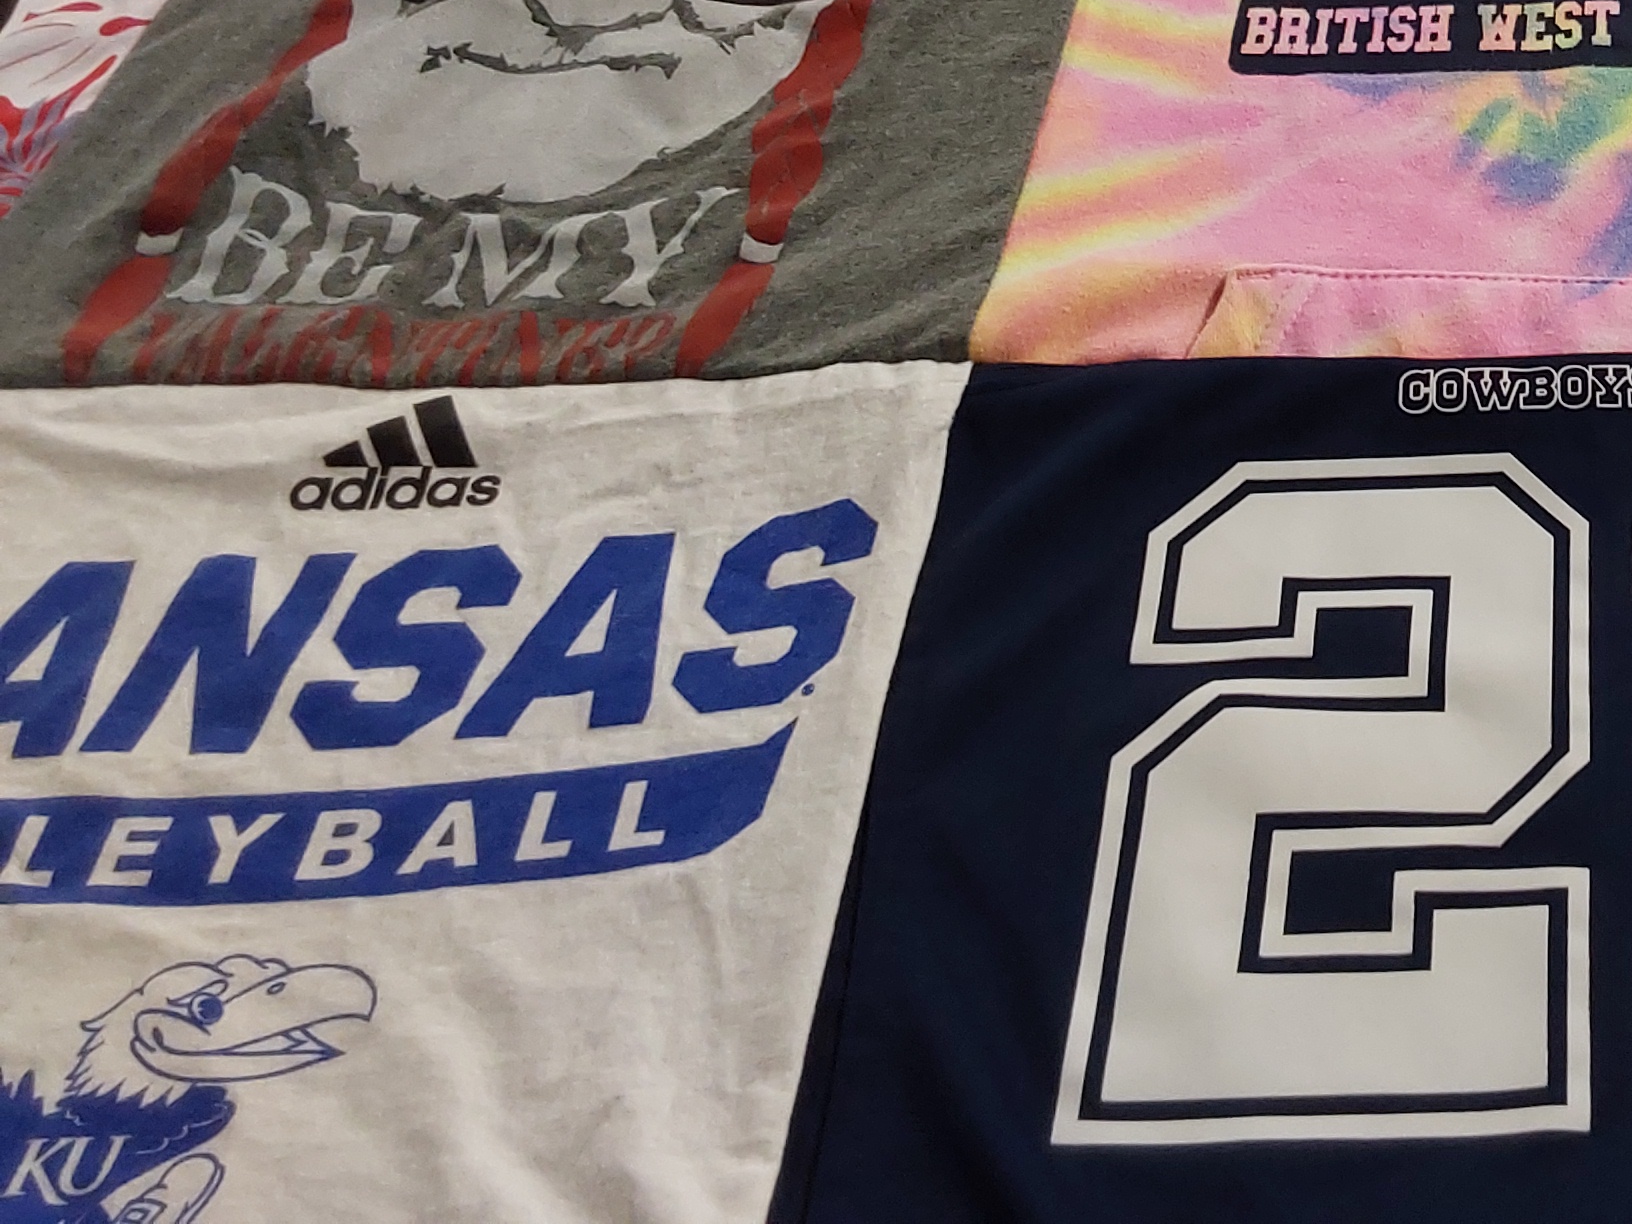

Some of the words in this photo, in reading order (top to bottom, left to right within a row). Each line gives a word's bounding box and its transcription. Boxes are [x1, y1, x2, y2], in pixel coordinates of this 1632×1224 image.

[1240, 6, 1452, 57] BRITISH
[1478, 1, 1621, 53] WEST
[164, 165, 424, 308] BE
[421, 184, 745, 308] MY
[289, 467, 502, 512] adidas
[0, 498, 878, 759] ANSAS
[0, 780, 667, 888] LEYBALL
[3, 1135, 132, 1206] KU
